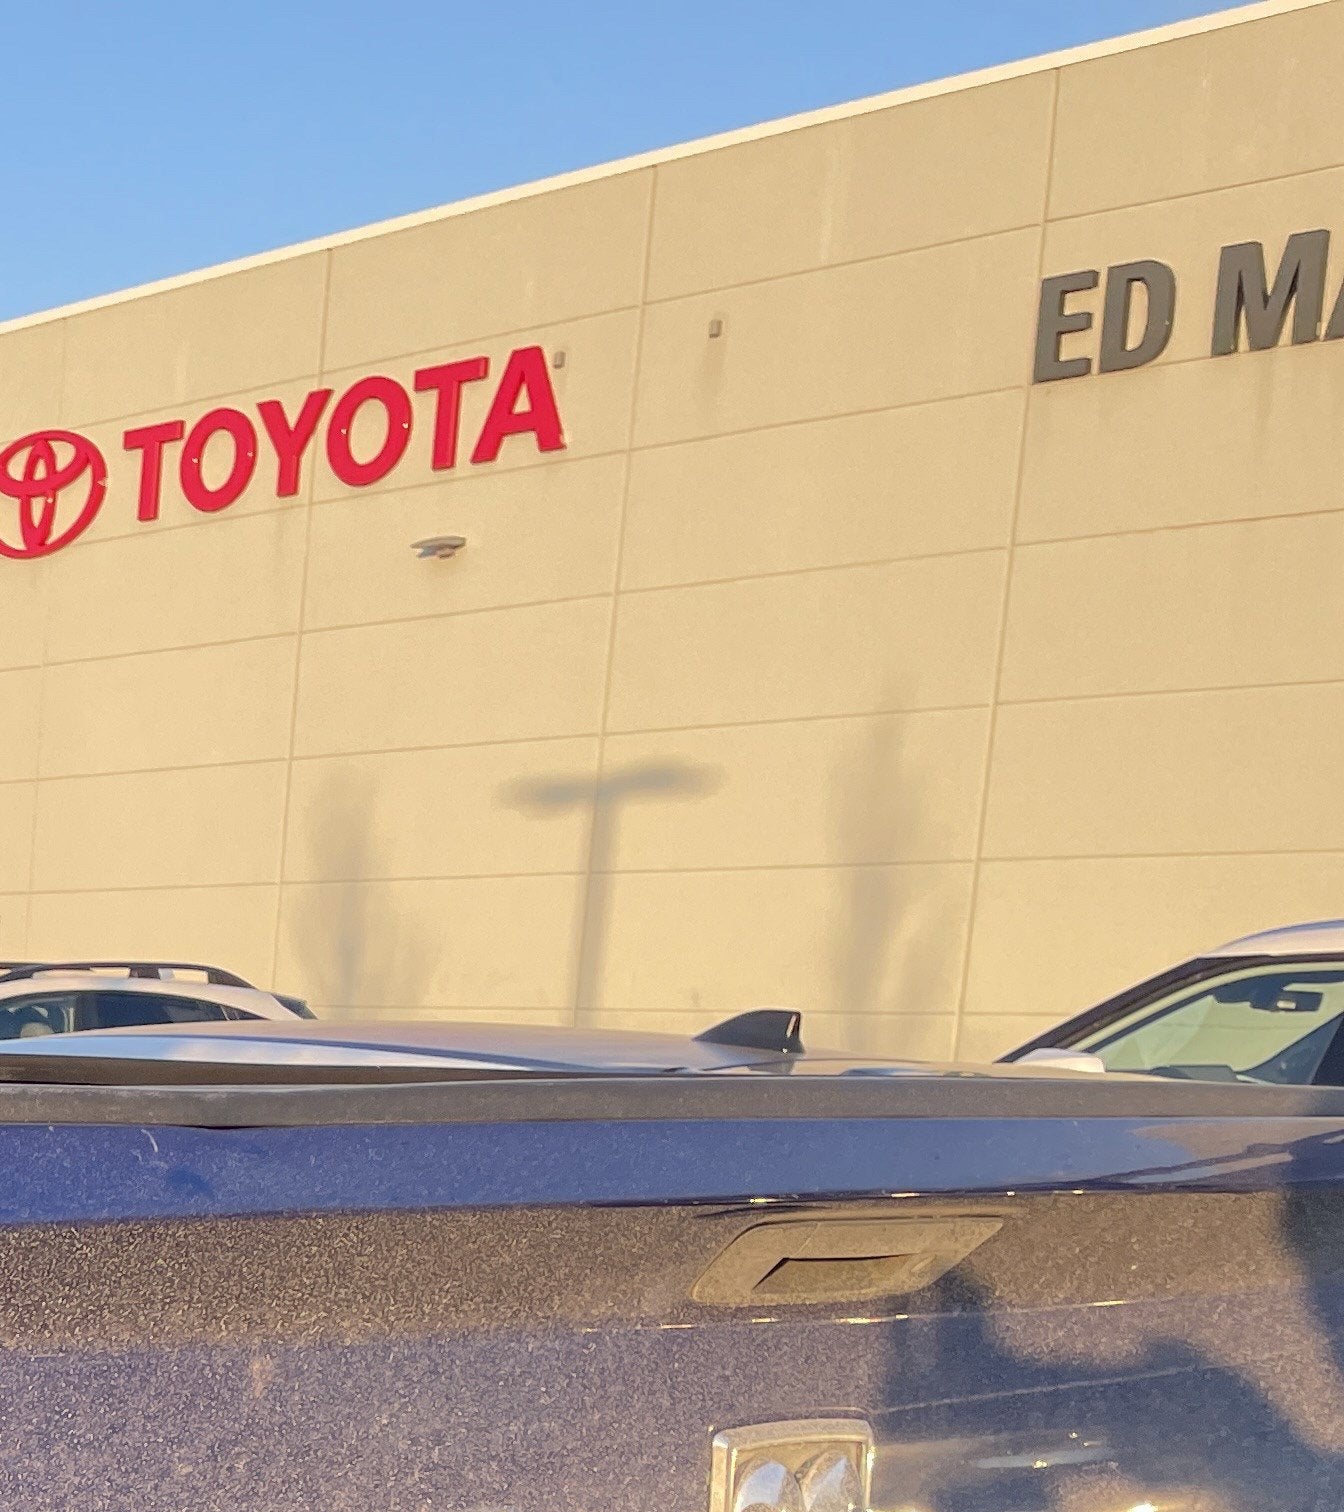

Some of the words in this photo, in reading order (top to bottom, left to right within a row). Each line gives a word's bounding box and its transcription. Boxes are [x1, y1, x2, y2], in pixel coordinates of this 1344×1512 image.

[1032, 259, 1176, 385] ED
[1211, 228, 1344, 358] M
[123, 345, 567, 521] TOYOTA
